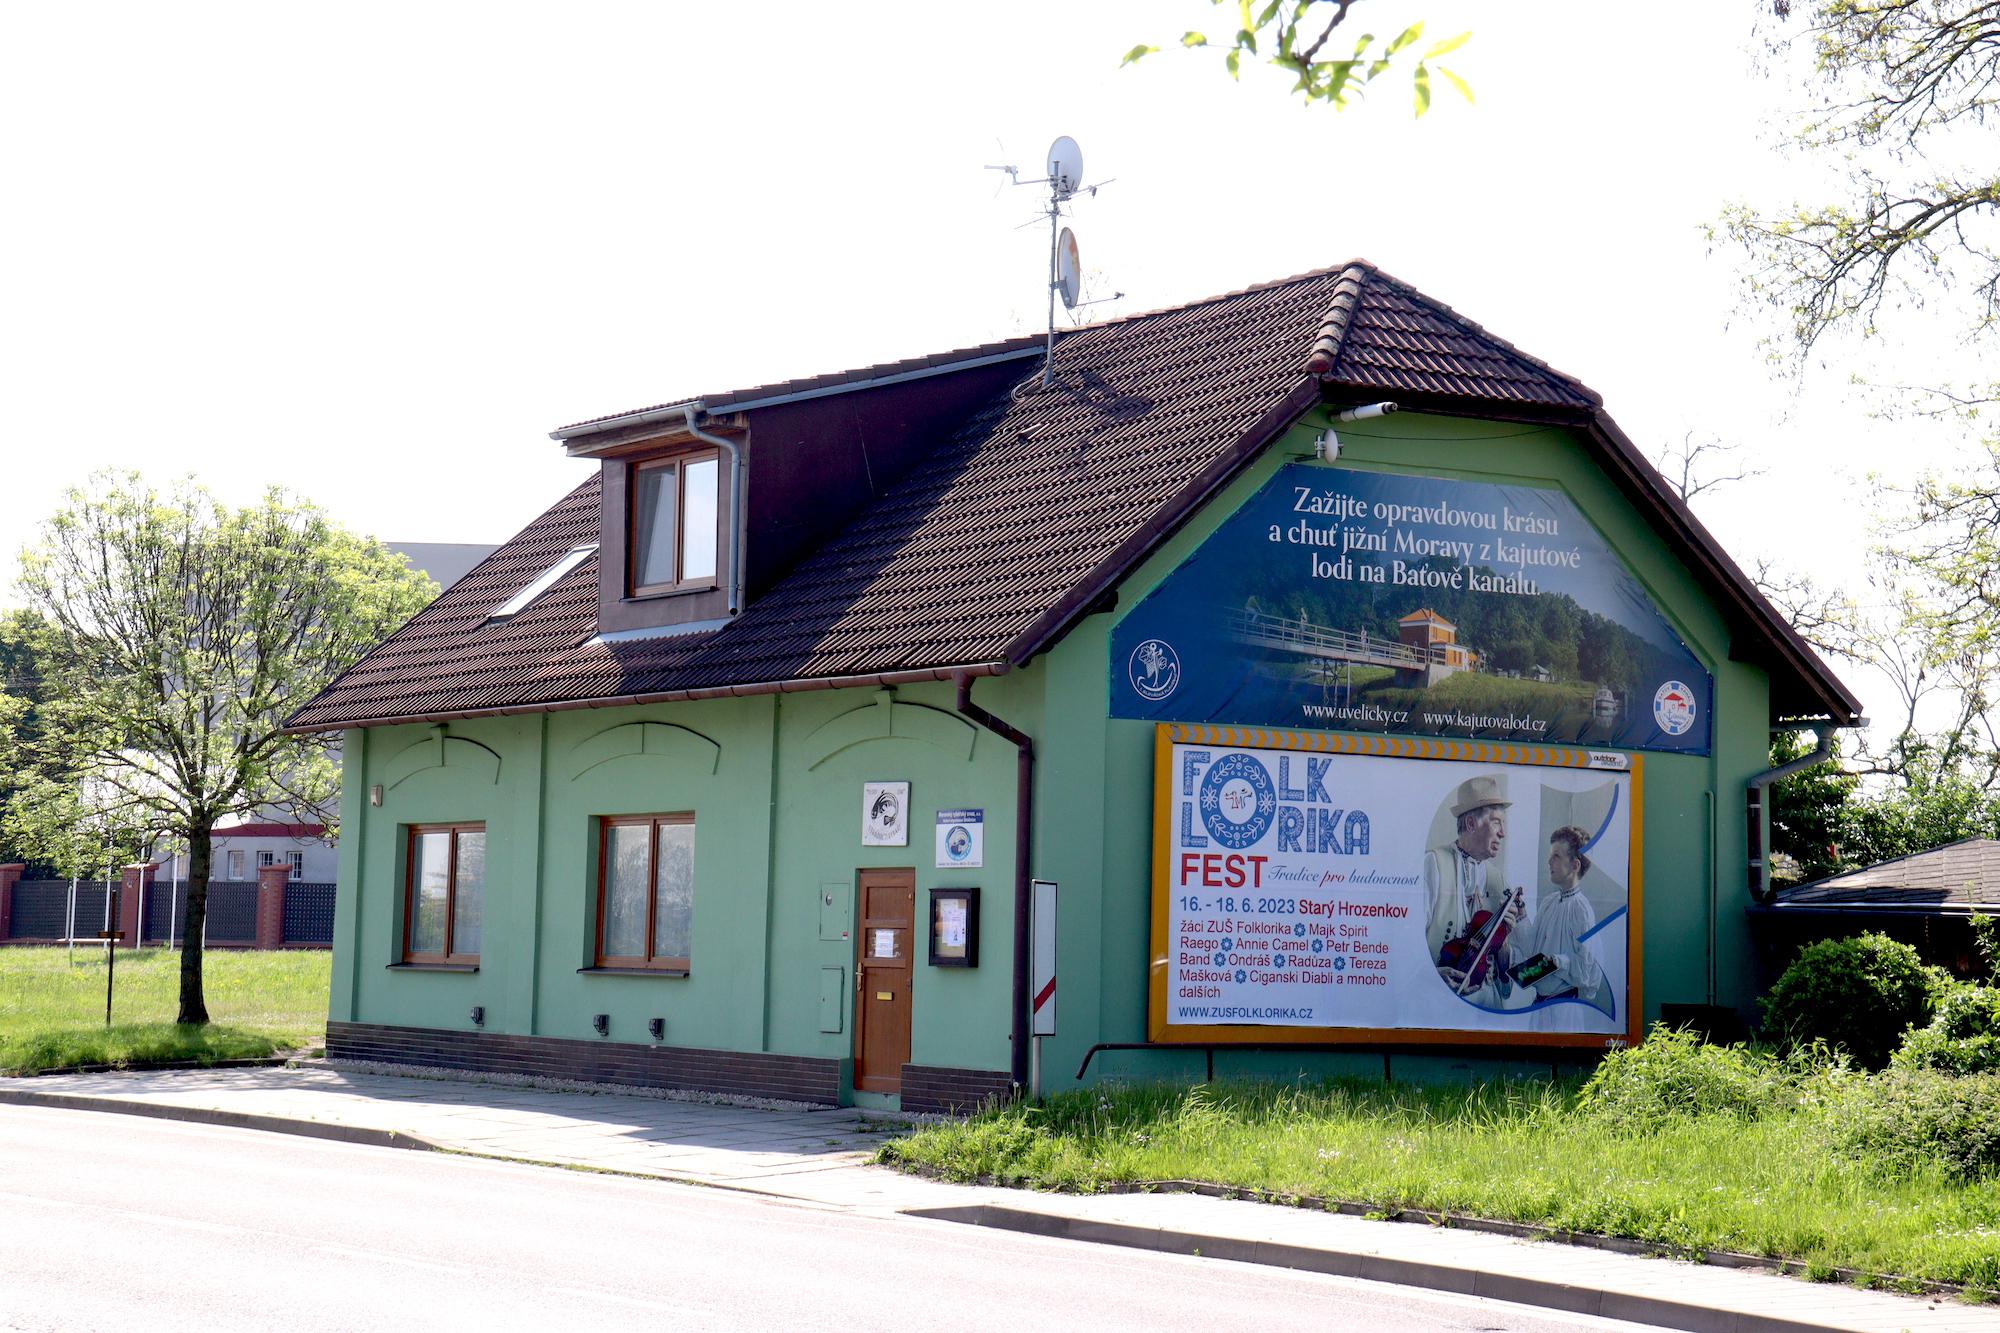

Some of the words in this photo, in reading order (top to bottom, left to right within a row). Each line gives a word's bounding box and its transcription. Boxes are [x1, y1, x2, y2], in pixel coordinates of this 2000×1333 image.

[1293, 486, 1368, 523] Zažijte
[1373, 501, 1496, 528] opravdovou
[1503, 507, 1559, 536] krásu
[1268, 524, 1281, 542] a
[1287, 519, 1338, 547] chuť
[1342, 526, 1387, 555] jižní
[1394, 528, 1474, 566] Moravy
[1480, 543, 1491, 561] z
[1497, 537, 1581, 570] kajutové
[1311, 552, 1353, 581] lodi
[1360, 565, 1385, 584] na
[1392, 560, 1462, 590] Baťově
[1468, 566, 1541, 596] kanálu.
[1302, 703, 1408, 726] www.uvelicky.cz
[1423, 710, 1547, 732] www.kajutovalod.cz
[1180, 853, 1268, 888] FEST
[1268, 865, 1320, 883] Tradice
[1319, 872, 1345, 888] pro
[1348, 869, 1420, 886] budoucnost
[1180, 896, 1202, 912] 16.
[1216, 897, 1238, 913] 18.
[1241, 898, 1254, 913] 6.
[1258, 898, 1295, 914] 2023
[1299, 899, 1335, 918] Starý
[1338, 901, 1409, 918] Hrozenkov
[1180, 920, 1203, 933] žáci
[1207, 918, 1233, 934] ZUŠ
[1237, 921, 1291, 935] Folklorika
[1309, 923, 1336, 937] Majk
[1339, 924, 1368, 938] Spirit
[1180, 937, 1219, 952] Raego
[1235, 938, 1268, 951] Annie
[1272, 938, 1309, 952] Camel
[1326, 940, 1350, 953] Petr
[1353, 940, 1389, 954] Bende
[1179, 953, 1210, 965] Band
[1228, 953, 1271, 967] Ondráš
[1348, 956, 1387, 970] Tereza
[1179, 969, 1232, 982] Mašková
[1249, 970, 1299, 985] Ciganski
[1302, 971, 1333, 985] Diabli
[1336, 975, 1344, 985] a
[1347, 972, 1386, 986] mnoho
[1179, 985, 1221, 998] dalších
[1178, 1006, 1313, 1019] WWW.ZUSFOLKLORIKA.CZ
